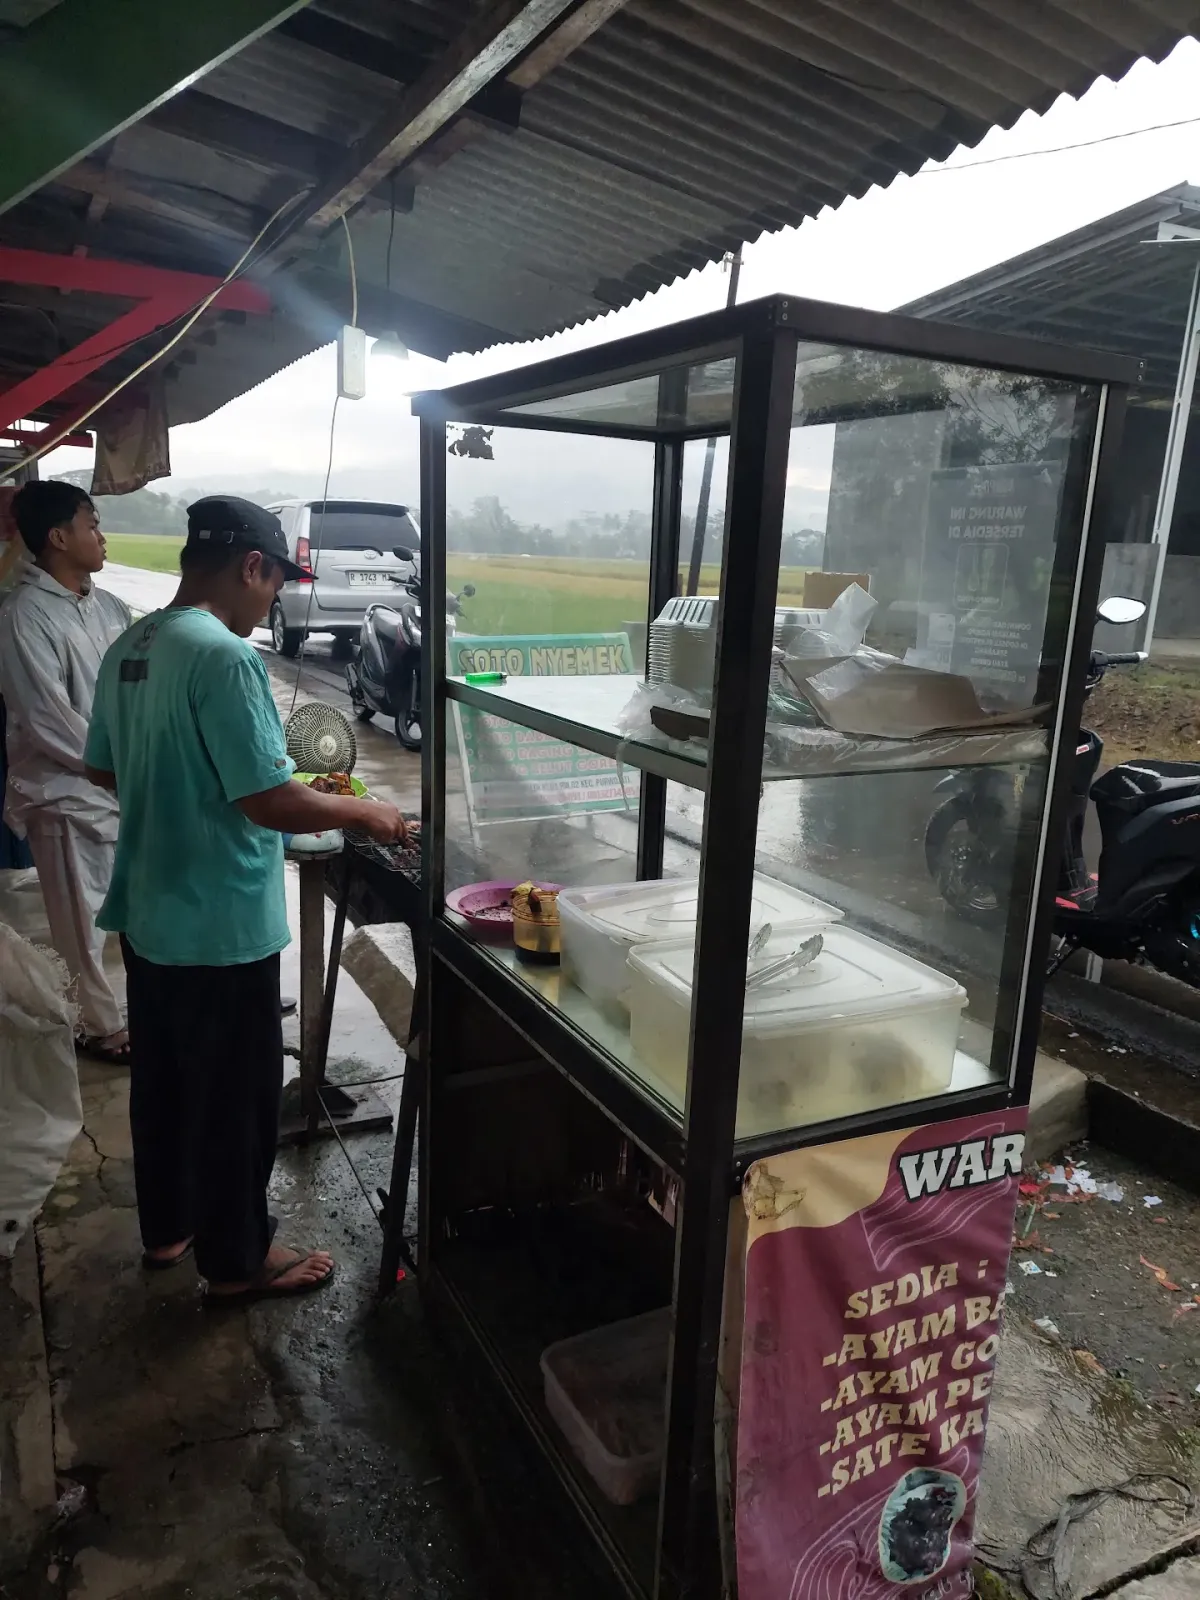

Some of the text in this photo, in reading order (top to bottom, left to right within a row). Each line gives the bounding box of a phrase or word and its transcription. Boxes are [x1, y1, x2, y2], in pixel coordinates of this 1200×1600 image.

[459, 644, 629, 676] SOTO NYEMEK
[900, 1132, 1026, 1200] WAR
[844, 1262, 959, 1319] SEDIA
[944, 1369, 994, 1409] PE
[938, 1408, 985, 1455] KA
